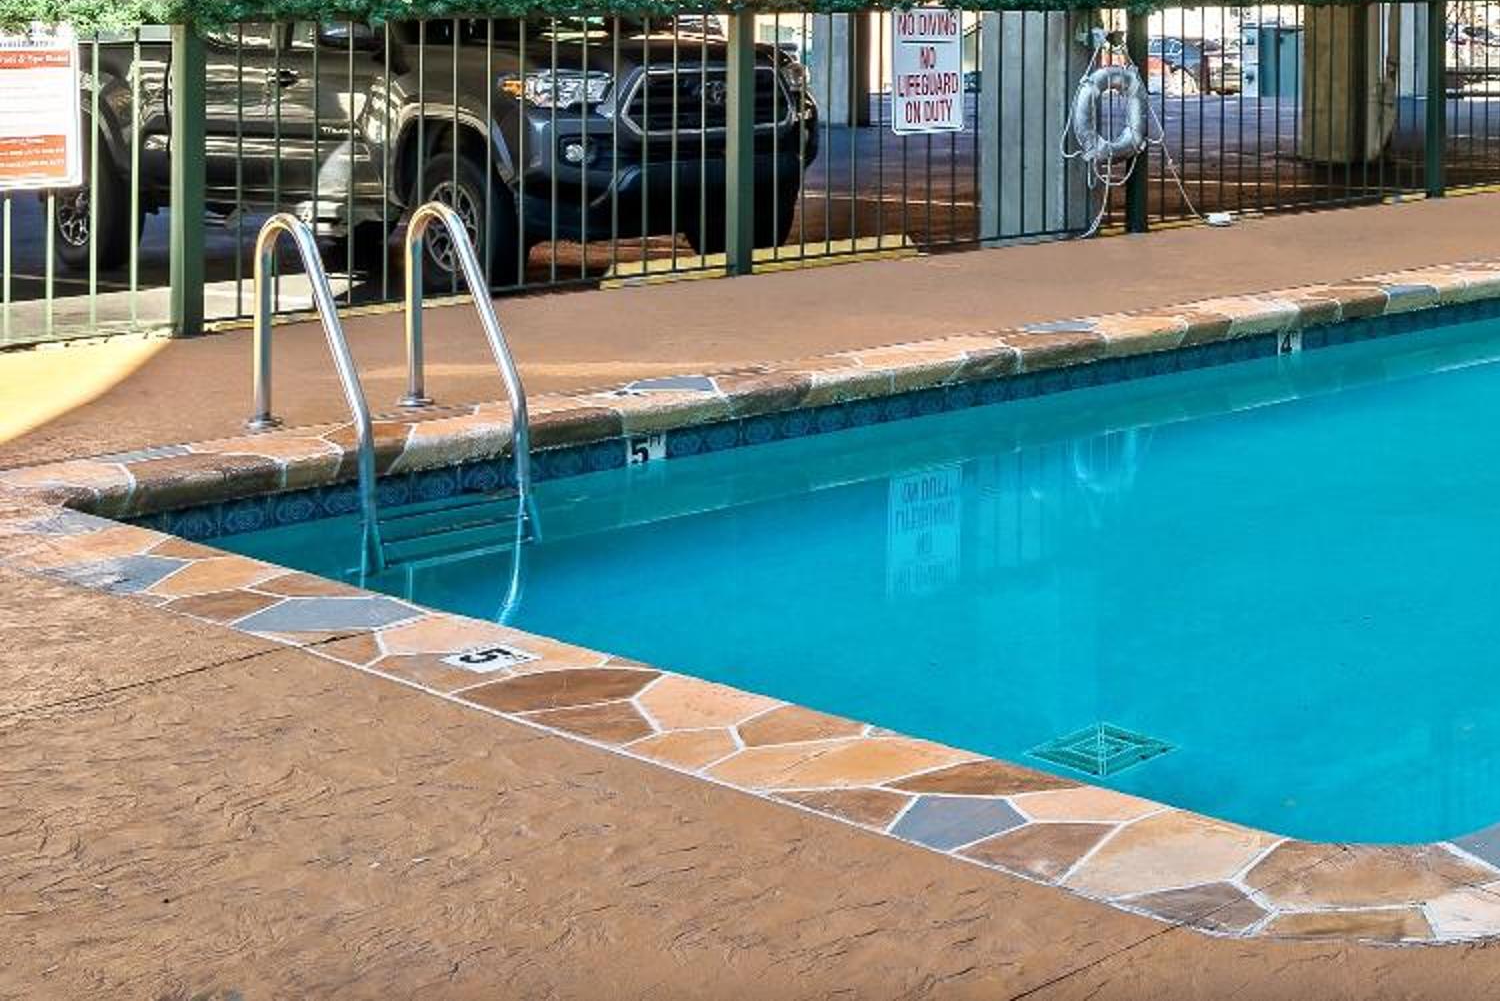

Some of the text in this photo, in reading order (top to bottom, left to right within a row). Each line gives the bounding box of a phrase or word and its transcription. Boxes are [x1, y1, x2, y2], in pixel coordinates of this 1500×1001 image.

[897, 13, 957, 36] NO DIVING
[920, 47, 937, 69] NO
[897, 72, 959, 98] LIFEGUARD
[905, 98, 953, 124] ON DUTY
